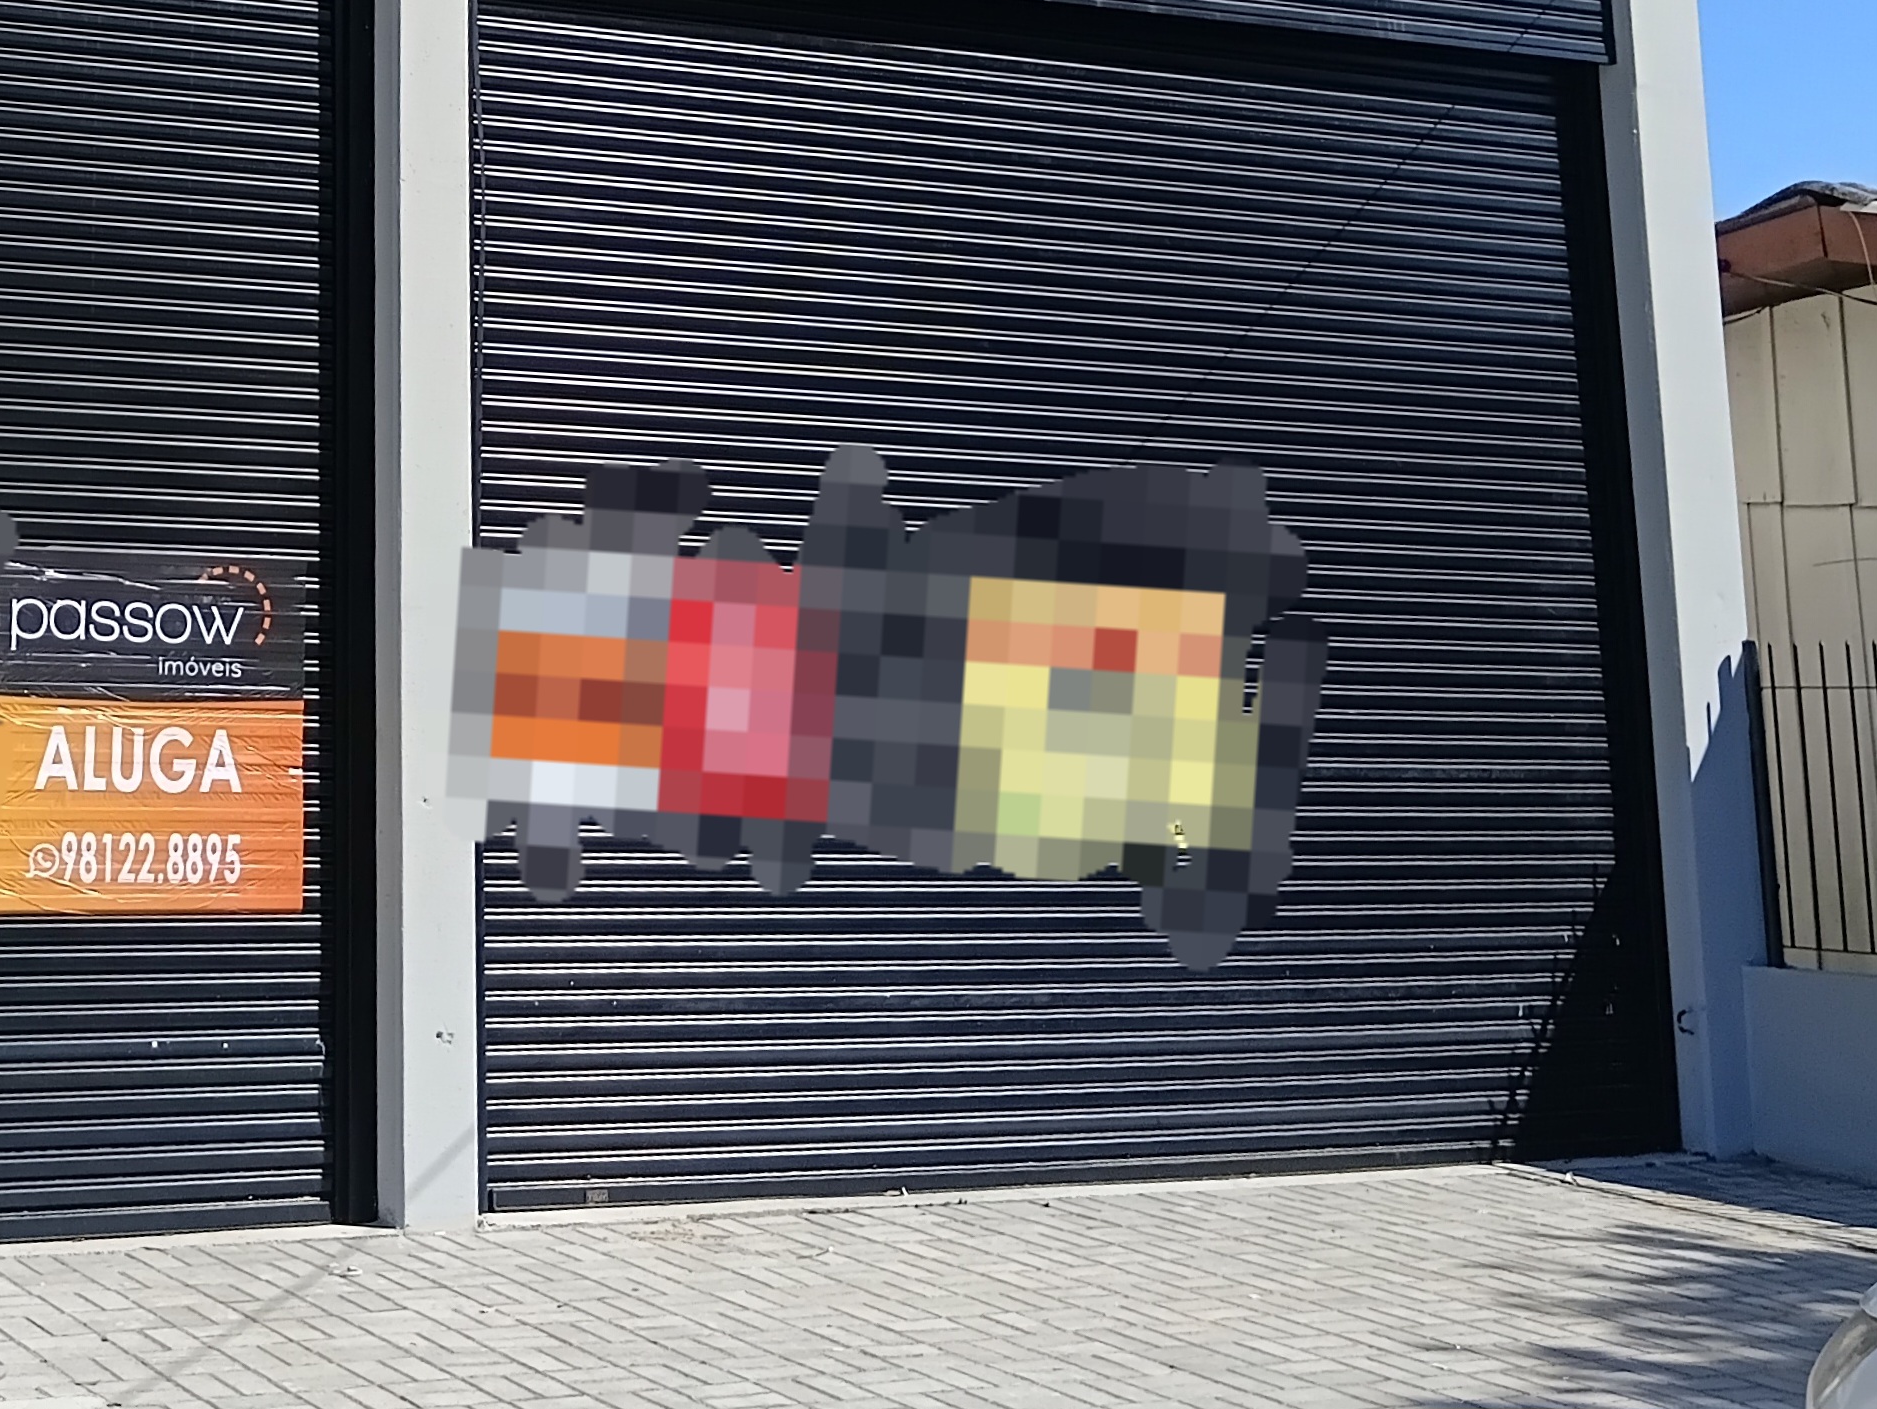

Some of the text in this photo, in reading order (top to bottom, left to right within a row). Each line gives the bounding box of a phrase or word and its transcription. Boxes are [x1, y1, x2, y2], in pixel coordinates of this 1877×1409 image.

[10, 598, 244, 650] passow
[158, 657, 243, 678] imóveis
[34, 725, 243, 794] ALUGA
[61, 831, 242, 885] 98122.8895
